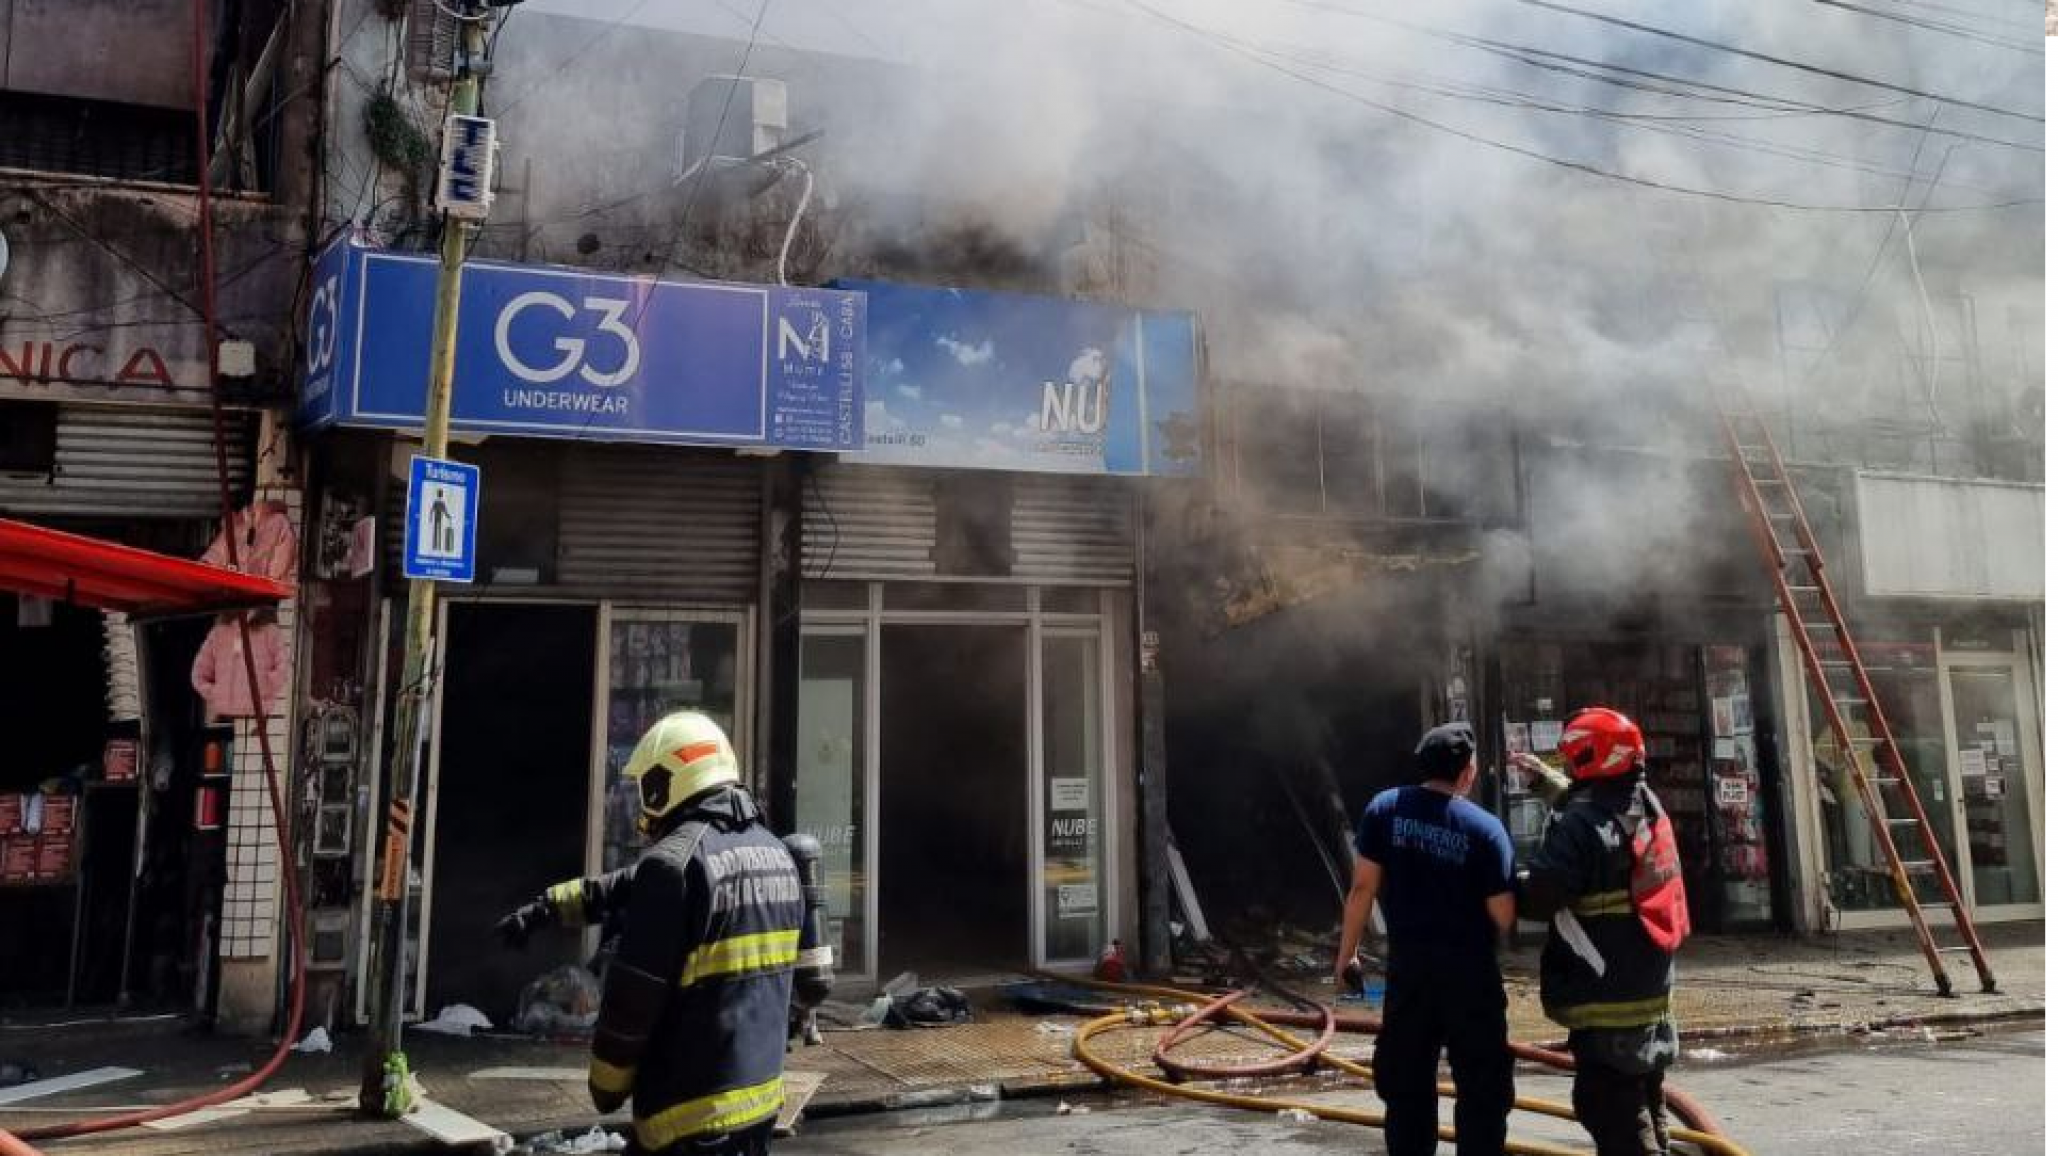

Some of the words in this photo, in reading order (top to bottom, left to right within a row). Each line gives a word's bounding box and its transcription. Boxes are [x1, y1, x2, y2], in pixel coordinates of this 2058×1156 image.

[494, 291, 640, 387] G3
[504, 389, 629, 414] UNDERWEAR
[1052, 819, 1098, 836] NUBE
